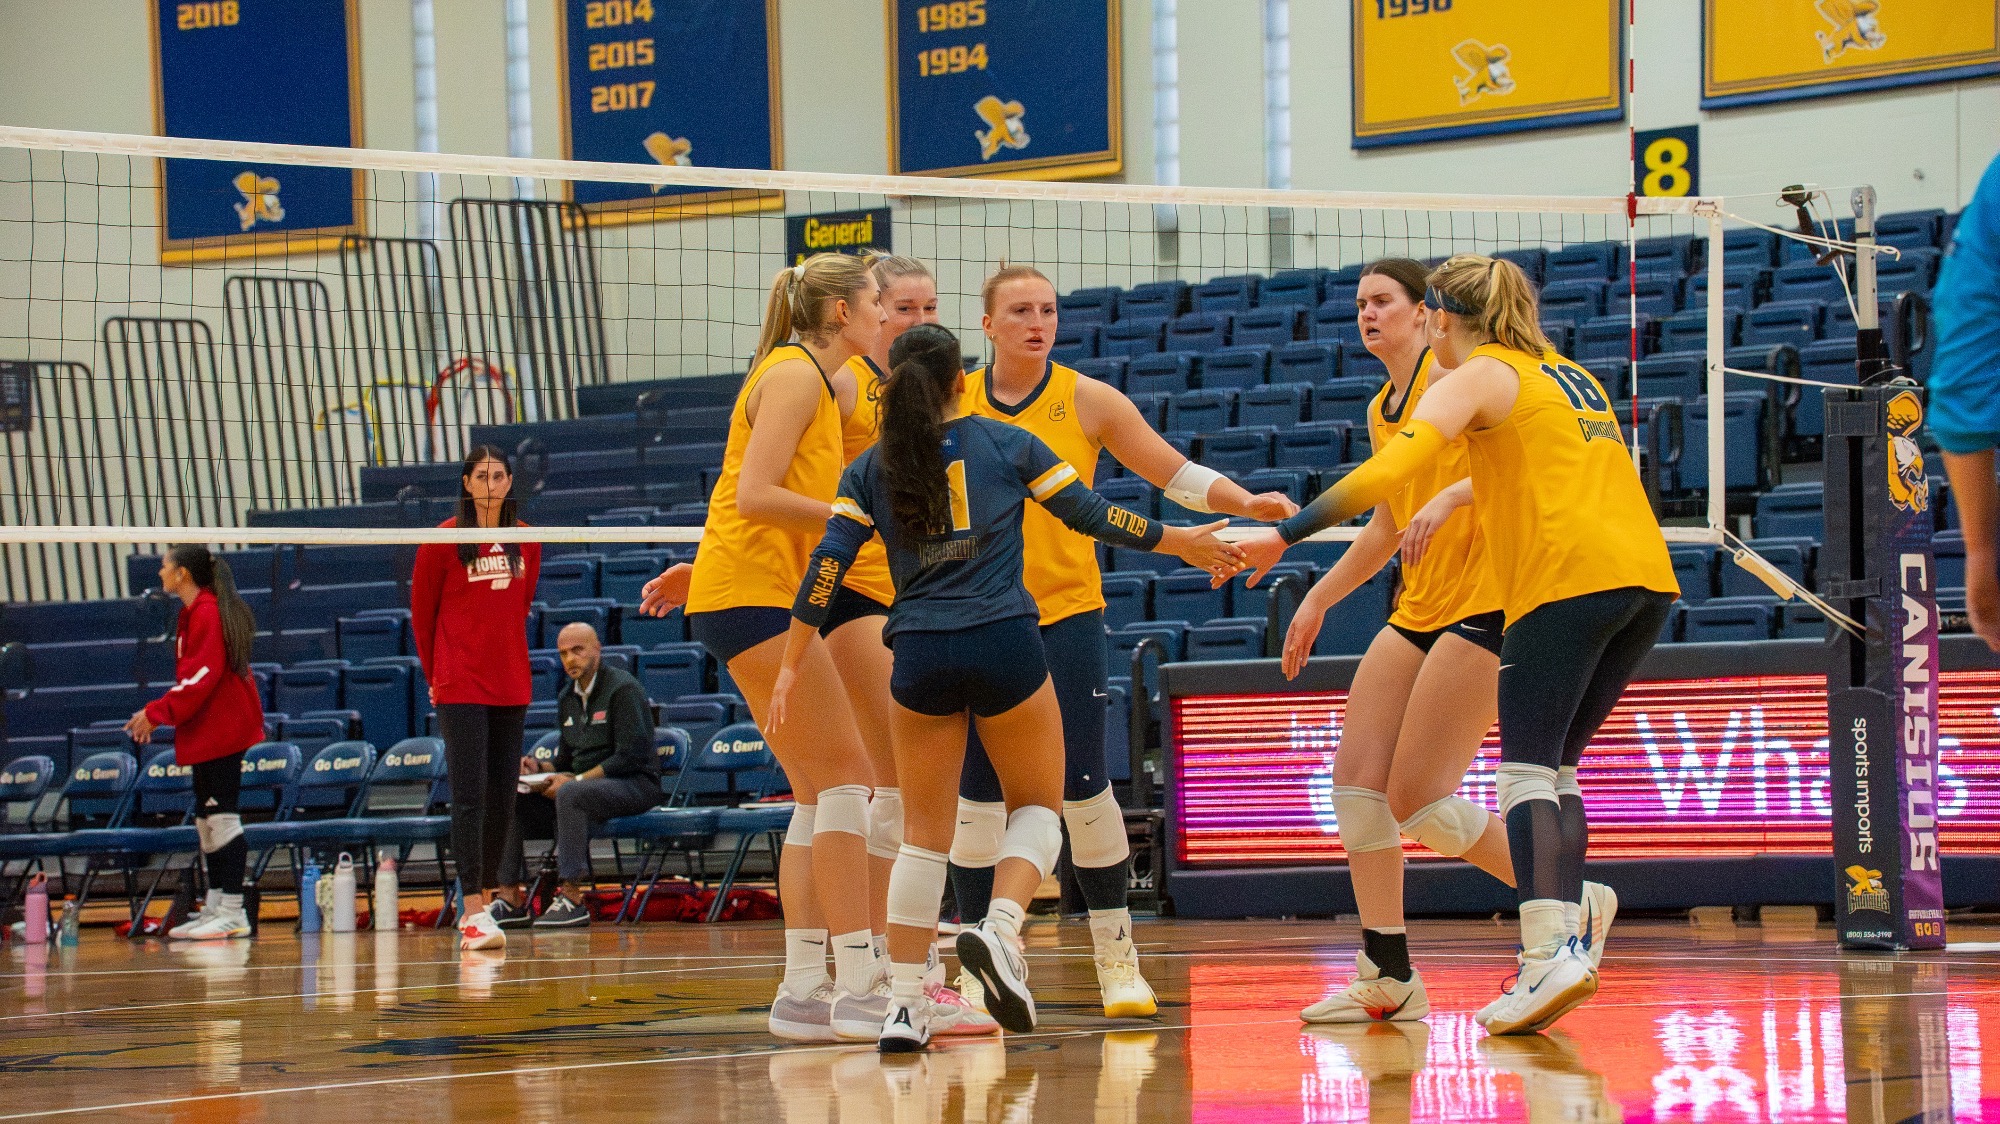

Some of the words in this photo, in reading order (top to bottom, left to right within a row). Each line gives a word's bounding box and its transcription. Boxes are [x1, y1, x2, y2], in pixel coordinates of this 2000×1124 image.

[177, 1, 239, 31] 2018
[586, 0, 654, 29] 2014
[918, 0, 986, 32] 1985
[588, 38, 655, 71] 2015
[918, 43, 988, 77] 1994
[591, 80, 656, 113] 2017
[1643, 137, 1691, 197] 8
[804, 213, 872, 248] General
[1540, 363, 1608, 413] 18
[1107, 505, 1148, 537] GOLDEN
[808, 557, 839, 608] GRIFFINS
[1900, 553, 1938, 871] CANISIUS
[713, 741, 730, 753] Go
[1851, 717, 1870, 777] sports
[1854, 780, 1873, 854] imports
